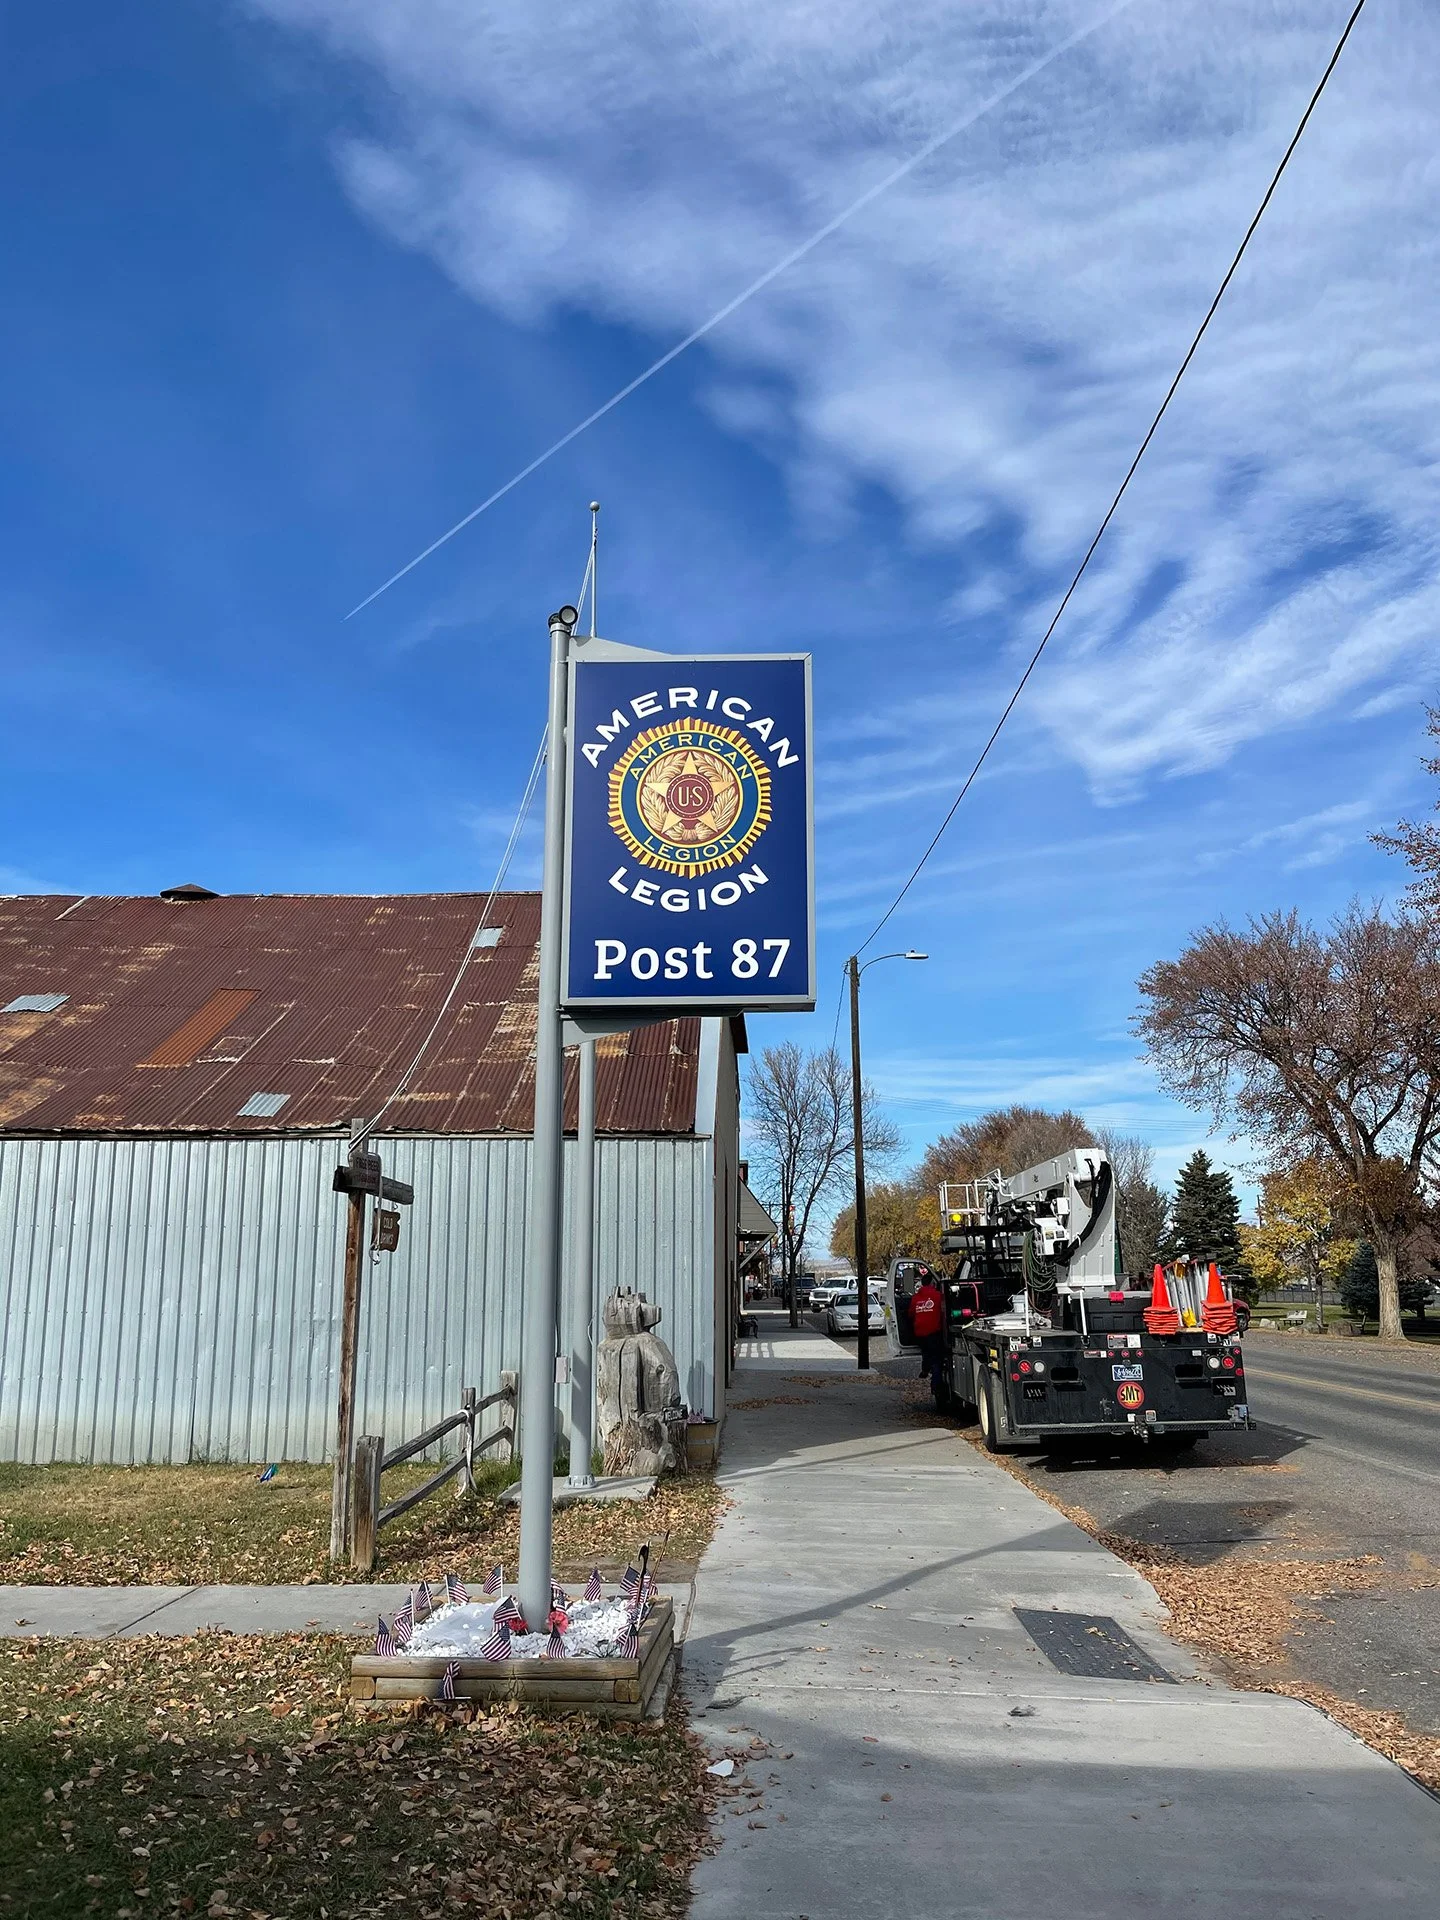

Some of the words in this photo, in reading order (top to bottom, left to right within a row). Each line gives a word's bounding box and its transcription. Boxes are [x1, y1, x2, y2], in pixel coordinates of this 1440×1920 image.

[580, 686, 800, 769] AMERICAN
[629, 733, 753, 781] AMERICAN
[642, 834, 737, 862] LEGION
[607, 863, 770, 912] LEGION
[593, 938, 714, 980] Post
[731, 938, 791, 979] 87
[1120, 1385, 1140, 1401] SMT
